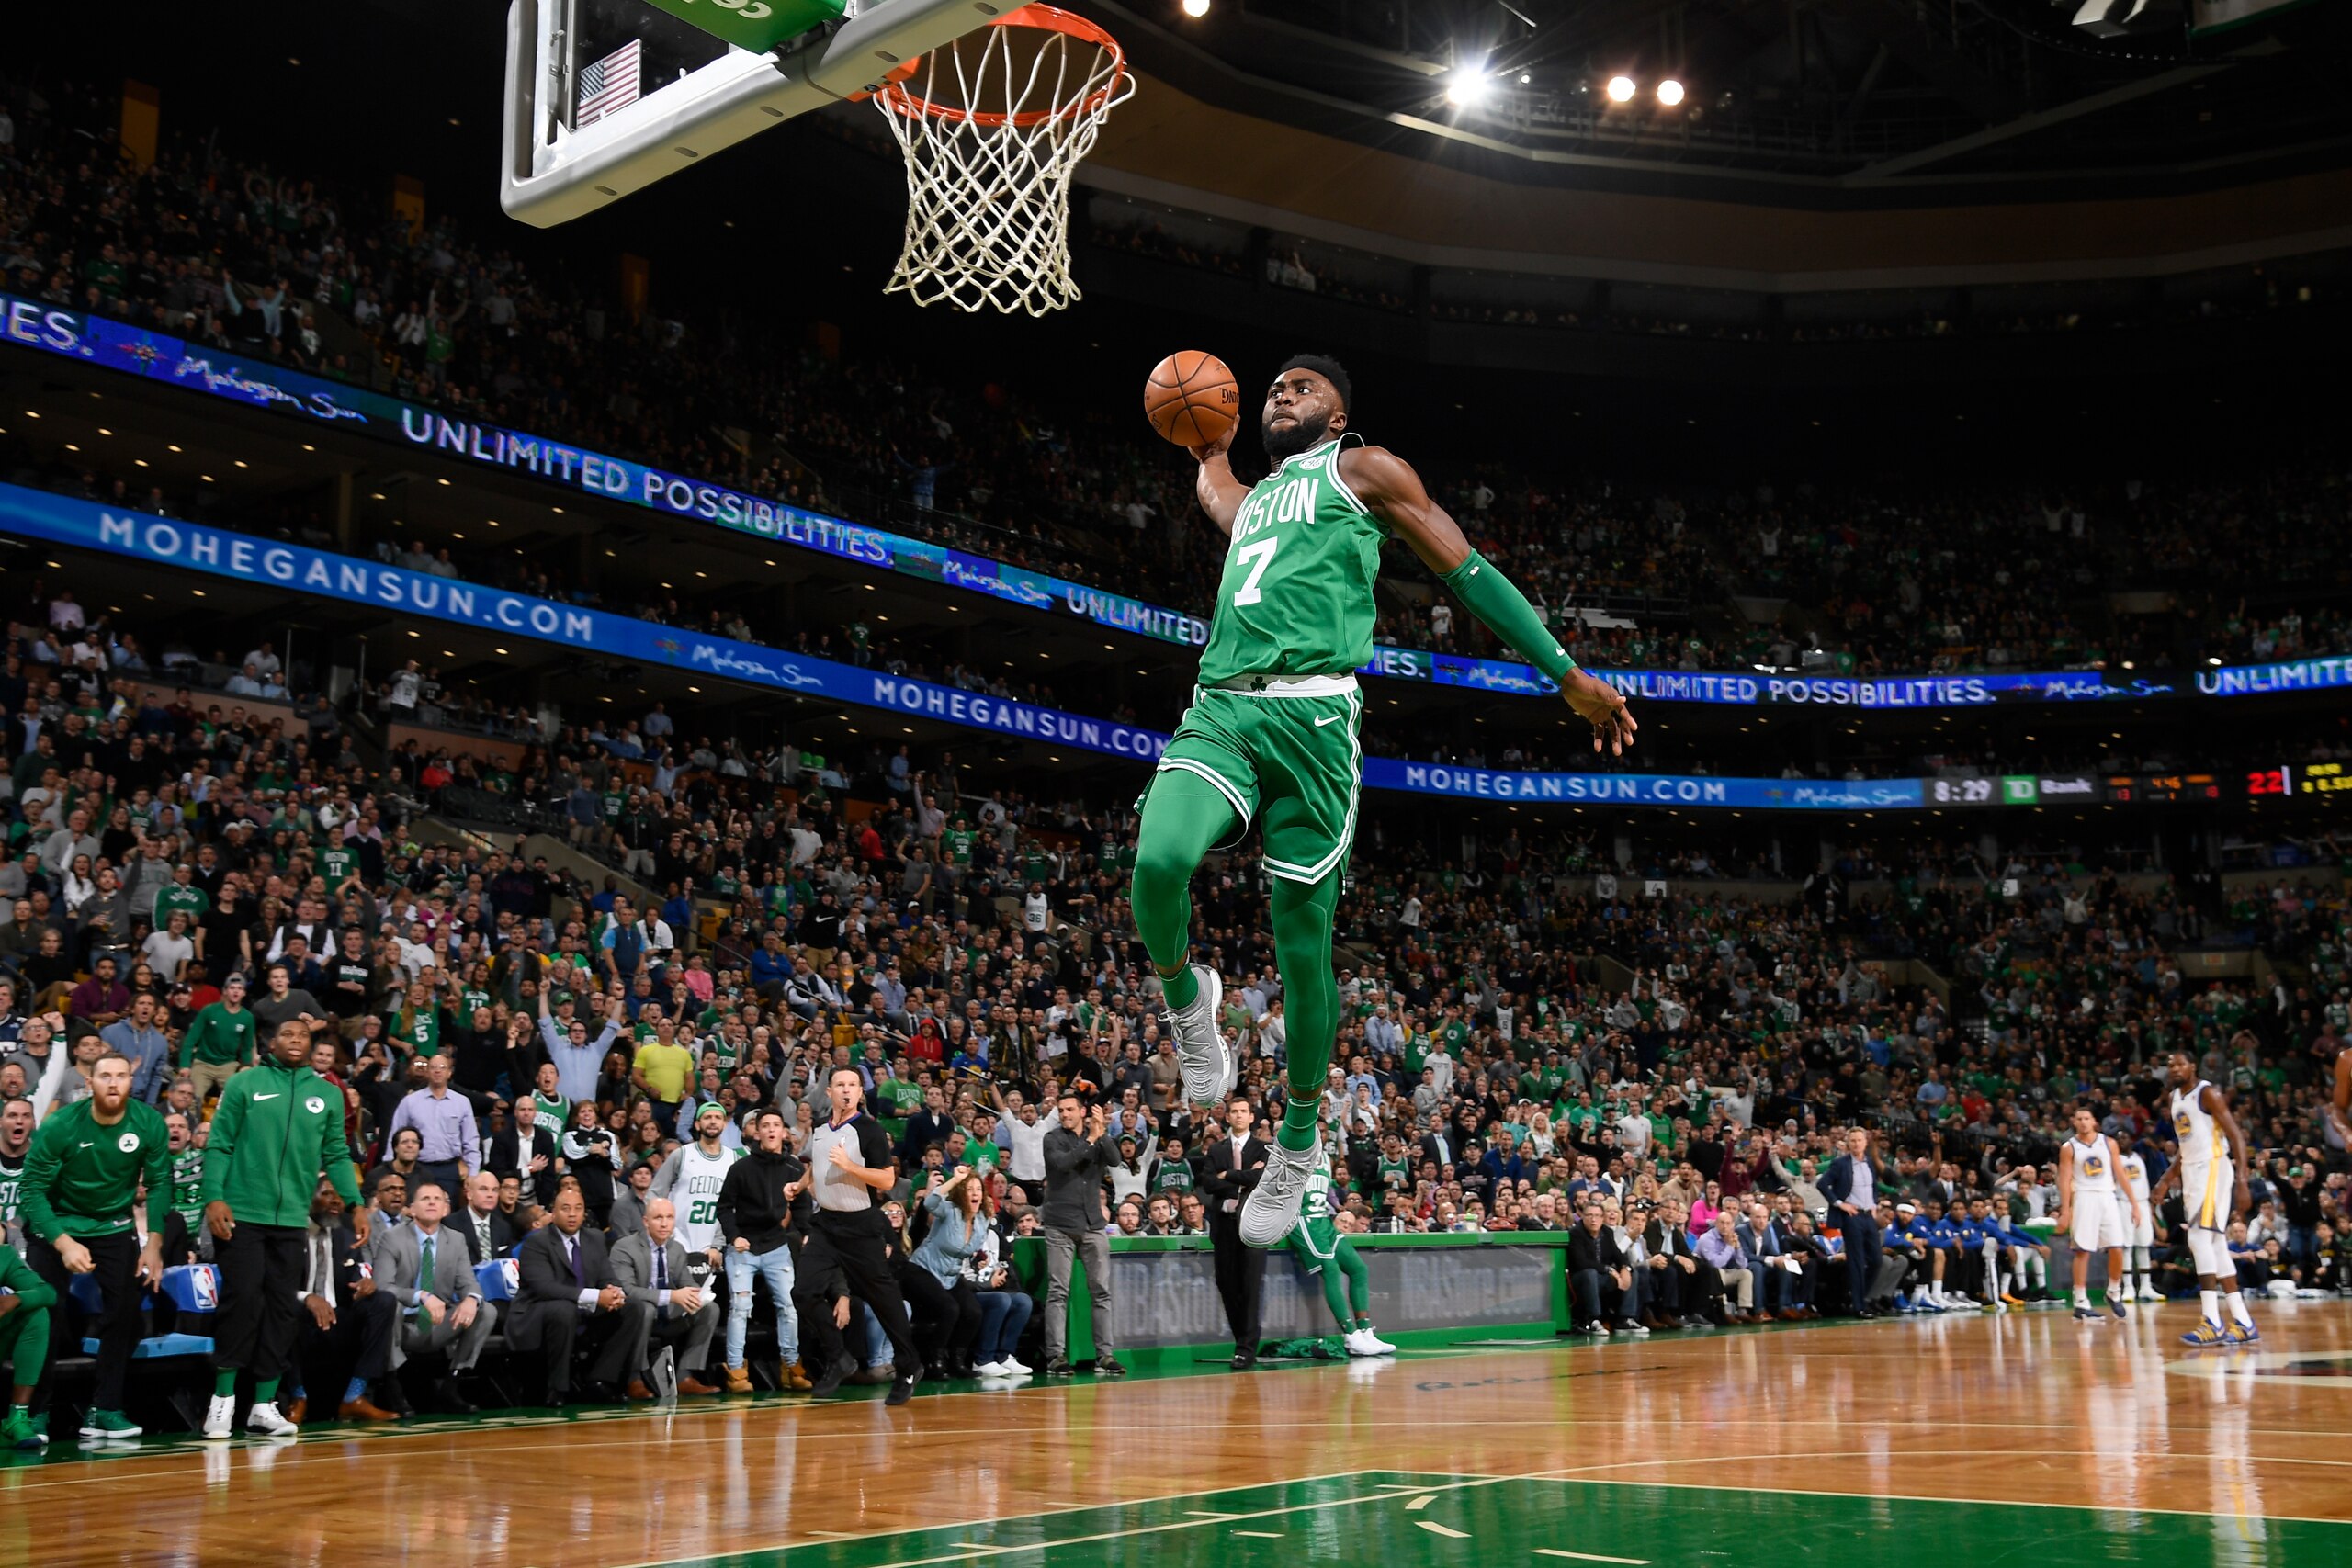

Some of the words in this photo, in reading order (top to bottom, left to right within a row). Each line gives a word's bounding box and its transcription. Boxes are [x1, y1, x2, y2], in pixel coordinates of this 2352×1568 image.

[402, 407, 629, 494] UNLIMITED
[643, 471, 895, 566] POSSIBILITIES.
[98, 512, 593, 643] MOHEGANSUN.COM
[1233, 536, 1278, 607] 7
[1066, 586, 1209, 646] UNLIMITED
[691, 644, 780, 682] Mohegan
[781, 664, 823, 687] Sun
[1362, 647, 1428, 679] IES.
[1769, 678, 1997, 705] POSSIBILITIES.
[1406, 766, 1726, 802] MOHEGANSUN.COM
[1934, 780, 1992, 802] 8:29
[2007, 781, 2035, 798] TD
[2040, 778, 2093, 794] Bank
[2247, 772, 2283, 795] 22
[414, 1025, 429, 1043] 5
[1161, 1173, 1190, 1187] BOSTON
[689, 1200, 718, 1224] 20
